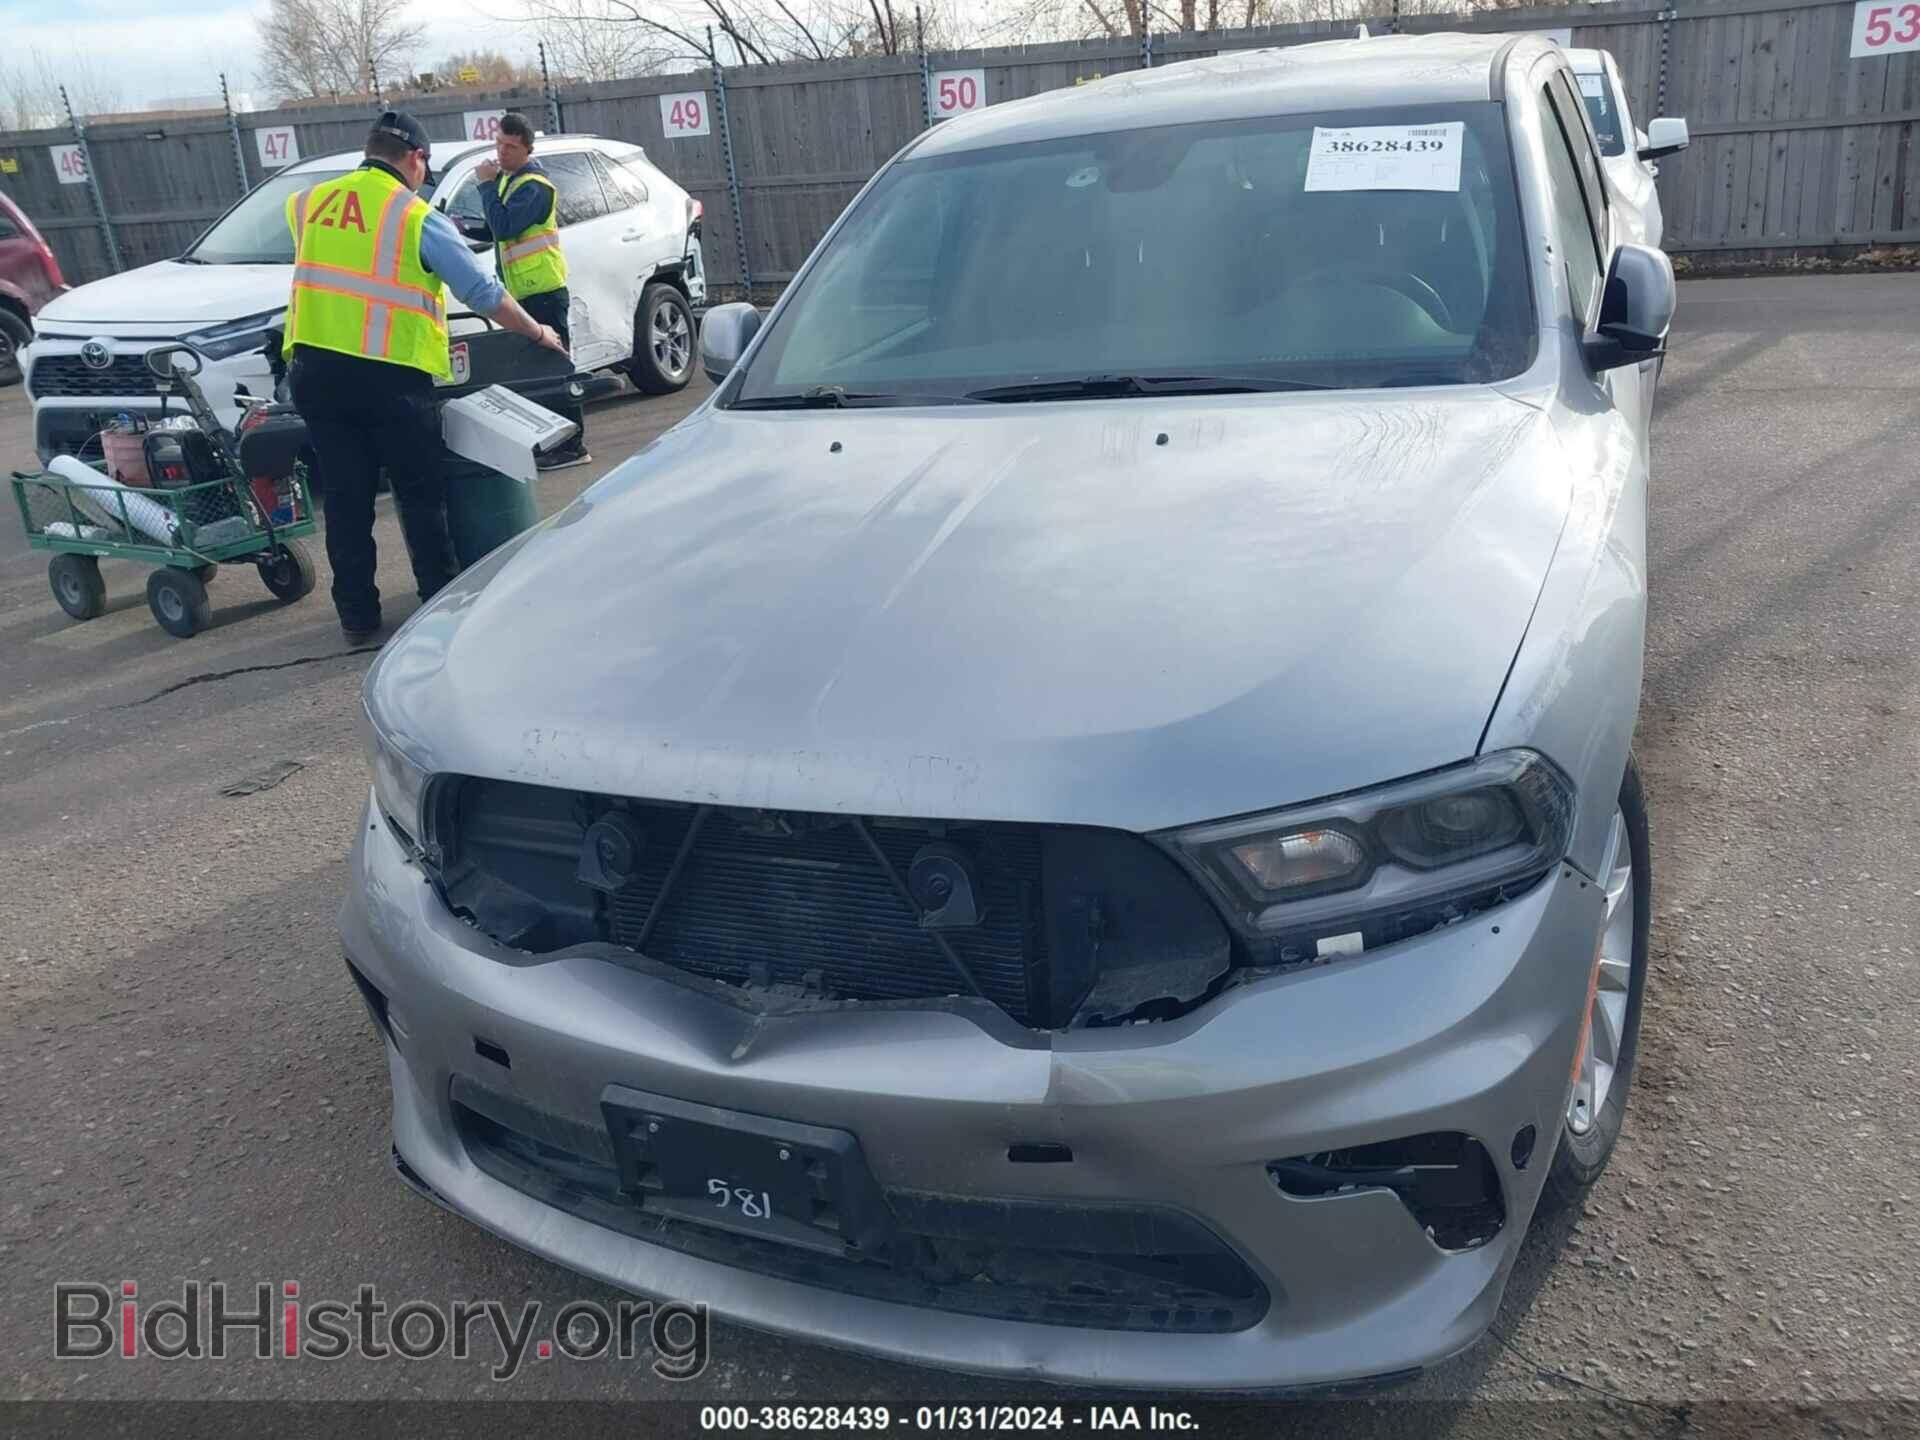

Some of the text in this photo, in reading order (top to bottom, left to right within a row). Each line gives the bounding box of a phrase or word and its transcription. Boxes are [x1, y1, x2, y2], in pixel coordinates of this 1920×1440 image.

[1865, 4, 1920, 46] 53
[939, 77, 976, 110] 50
[670, 99, 701, 129] 49
[473, 116, 500, 141] 48
[264, 133, 289, 160] 47
[1326, 140, 1444, 153] 38628439
[62, 151, 86, 176] 46
[707, 1178, 771, 1219] 581
